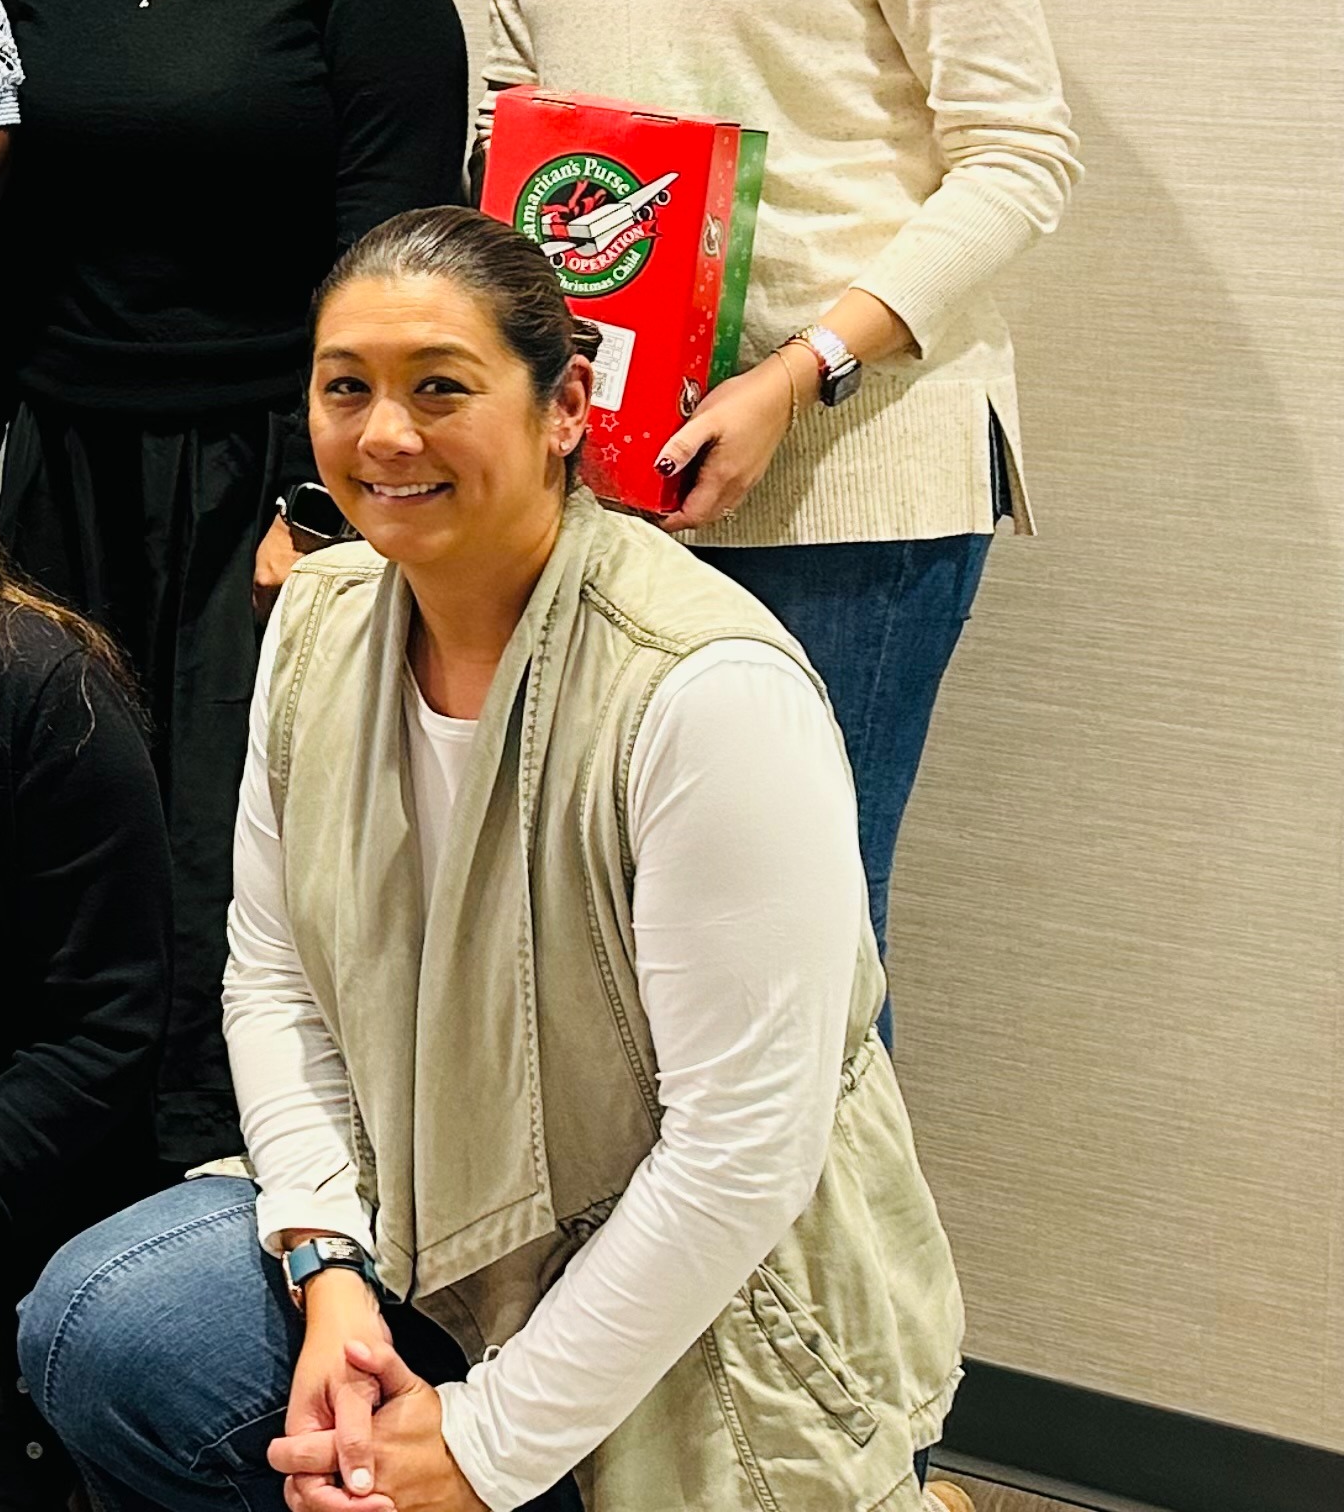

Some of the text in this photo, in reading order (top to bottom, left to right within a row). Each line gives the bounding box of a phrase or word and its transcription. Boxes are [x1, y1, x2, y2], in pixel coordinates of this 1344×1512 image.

[582, 157, 631, 195] Purse
[555, 248, 642, 292] hristmas Child
[569, 226, 645, 271] OPERATION
